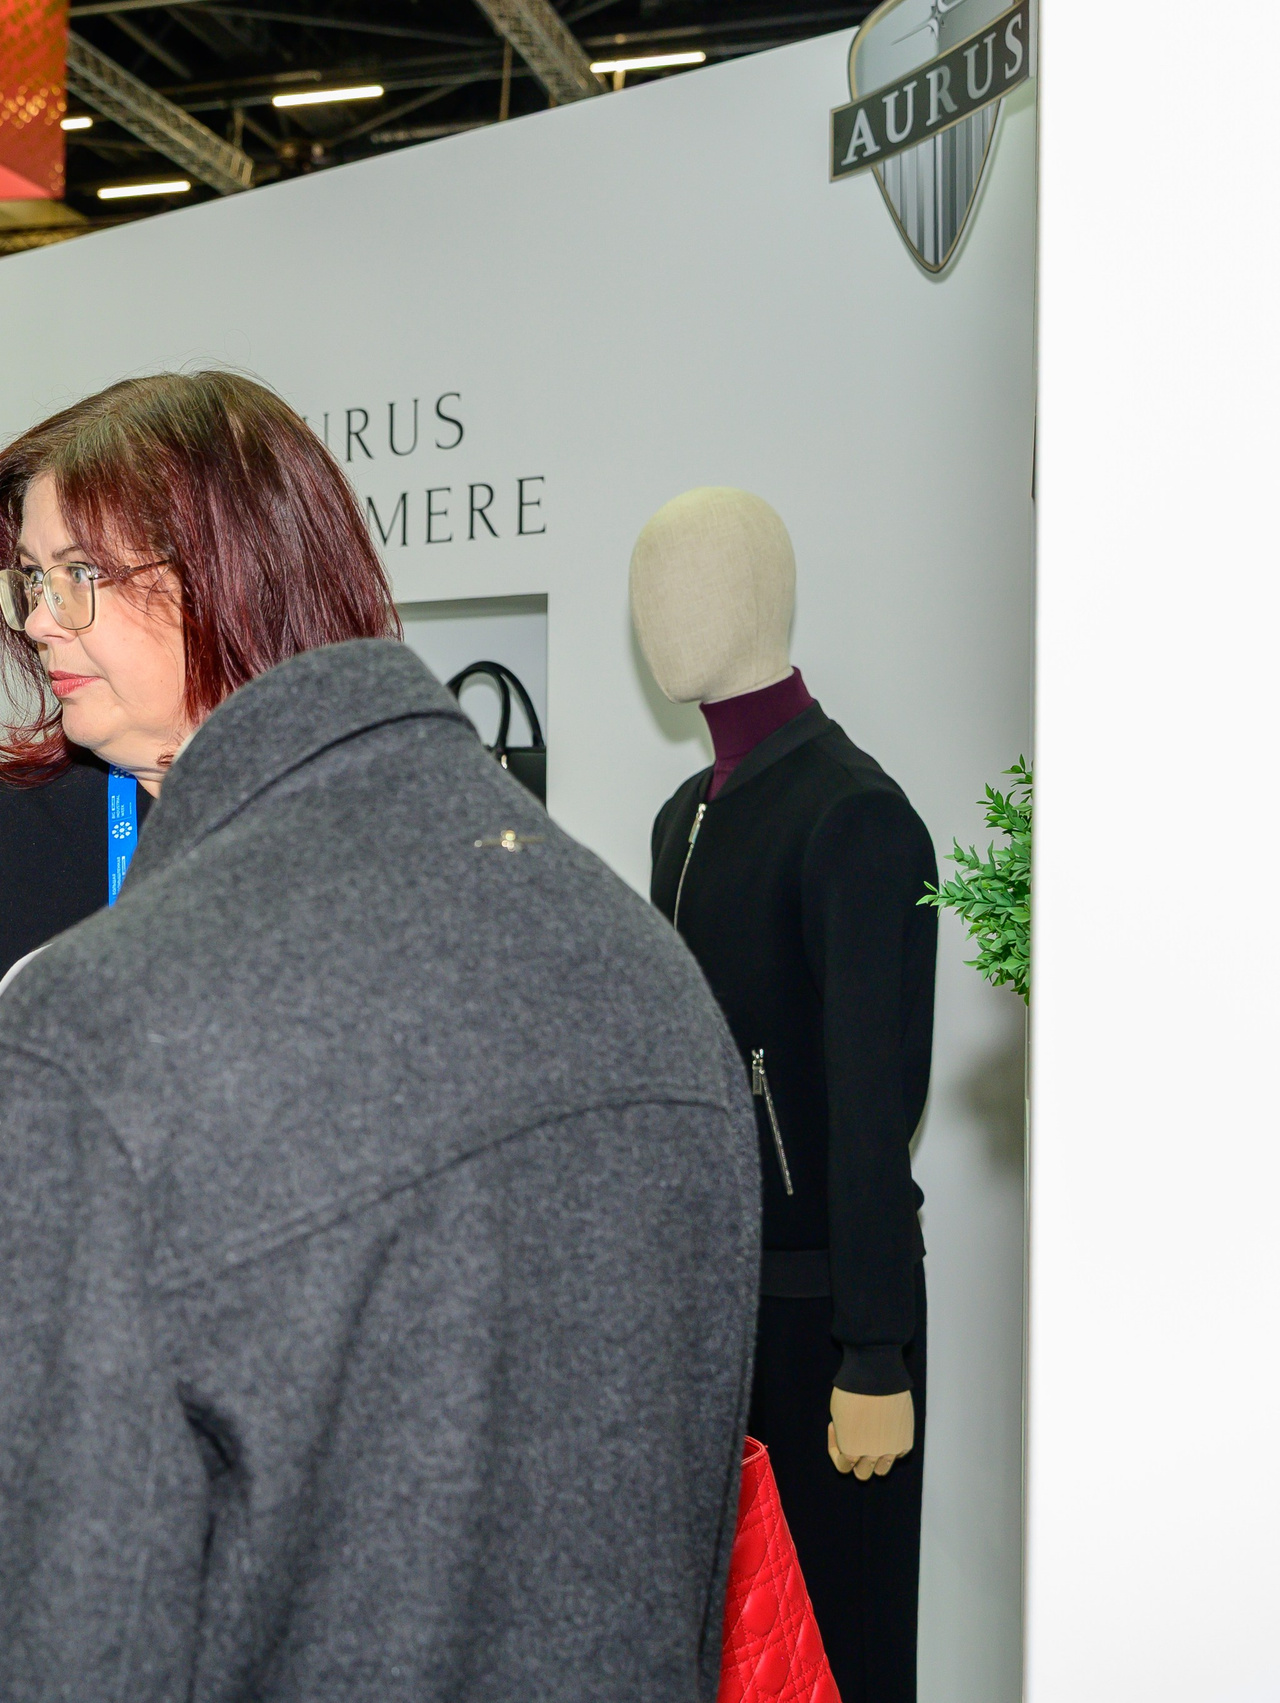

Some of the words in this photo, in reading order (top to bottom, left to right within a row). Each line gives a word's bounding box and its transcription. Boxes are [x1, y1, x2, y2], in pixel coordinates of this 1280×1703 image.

[840, 13, 1023, 166] AURUS
[302, 391, 465, 463] RUS
[366, 475, 547, 548] MERE
